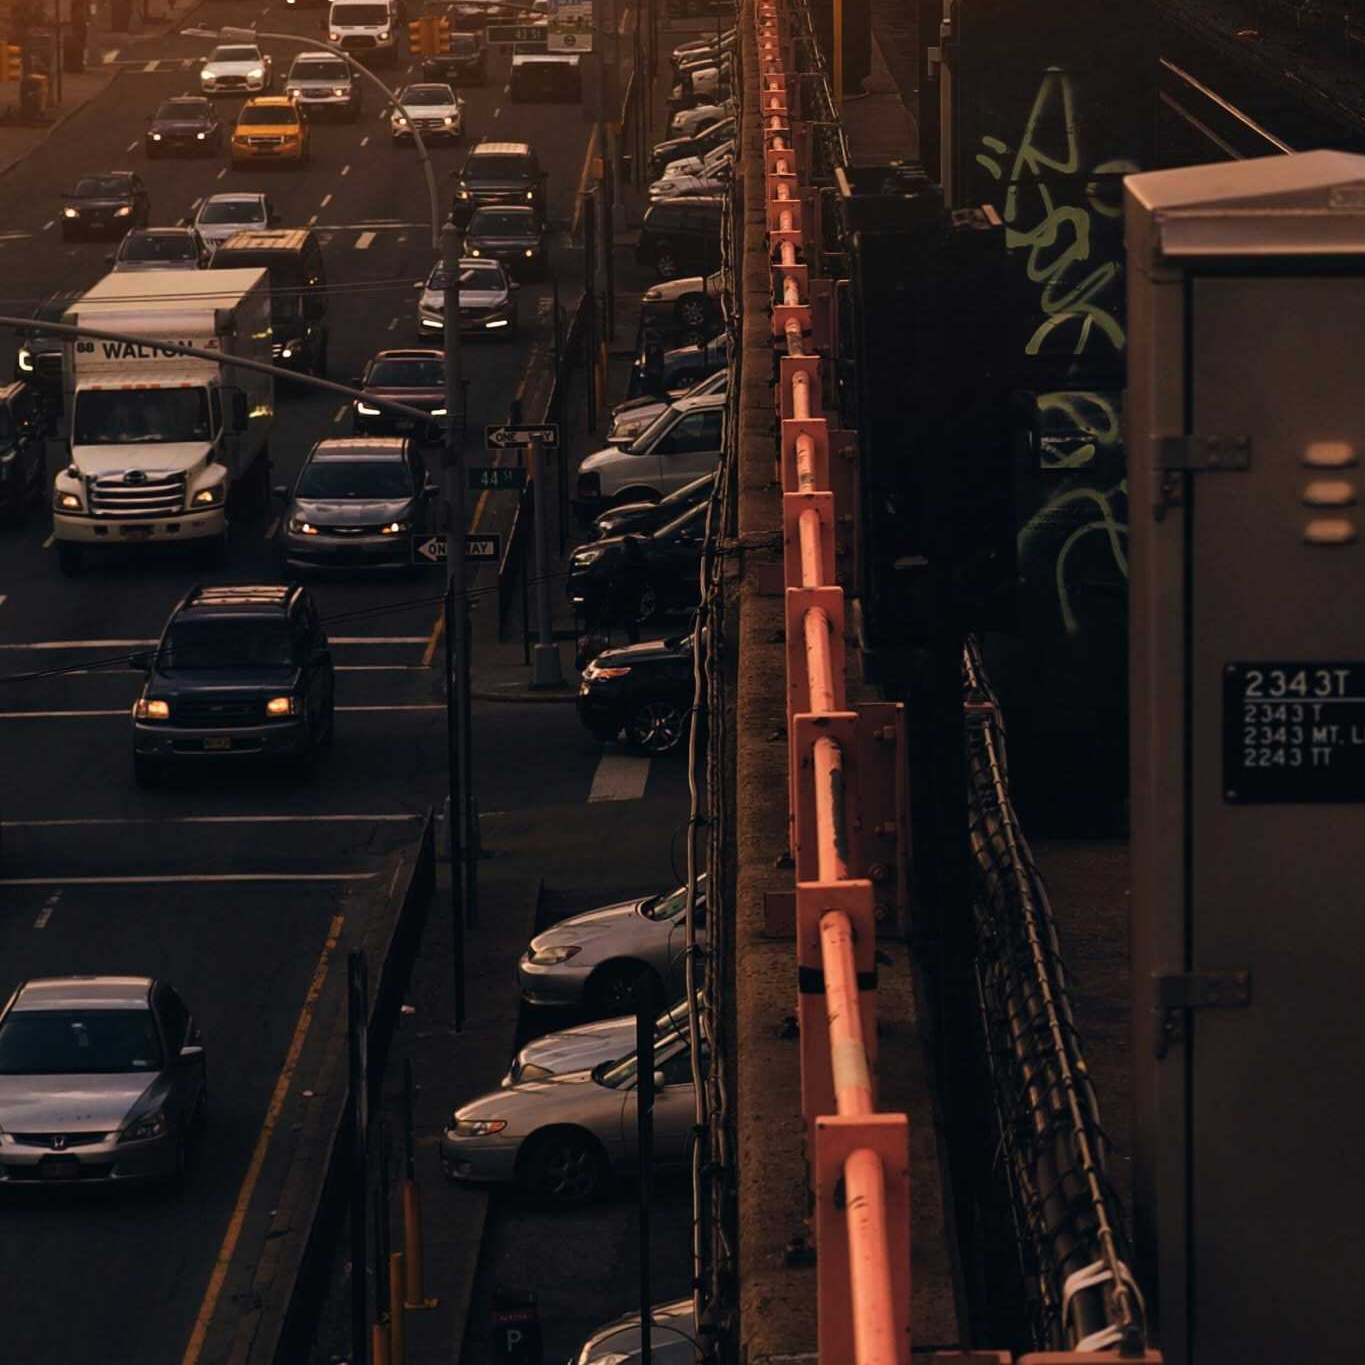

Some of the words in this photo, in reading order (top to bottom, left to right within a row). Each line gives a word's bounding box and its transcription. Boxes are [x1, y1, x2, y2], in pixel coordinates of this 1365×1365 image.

[495, 433, 516, 442] ONE
[481, 470, 498, 486] 44
[428, 544, 446, 555] ON
[1244, 668, 1352, 698] 2343T
[1243, 703, 1305, 724] 2343
[1313, 703, 1325, 723] T
[1243, 726, 1305, 746] 2343
[1243, 747, 1304, 767] 2243
[1311, 747, 1333, 767] TT
[507, 1330, 522, 1353] P
